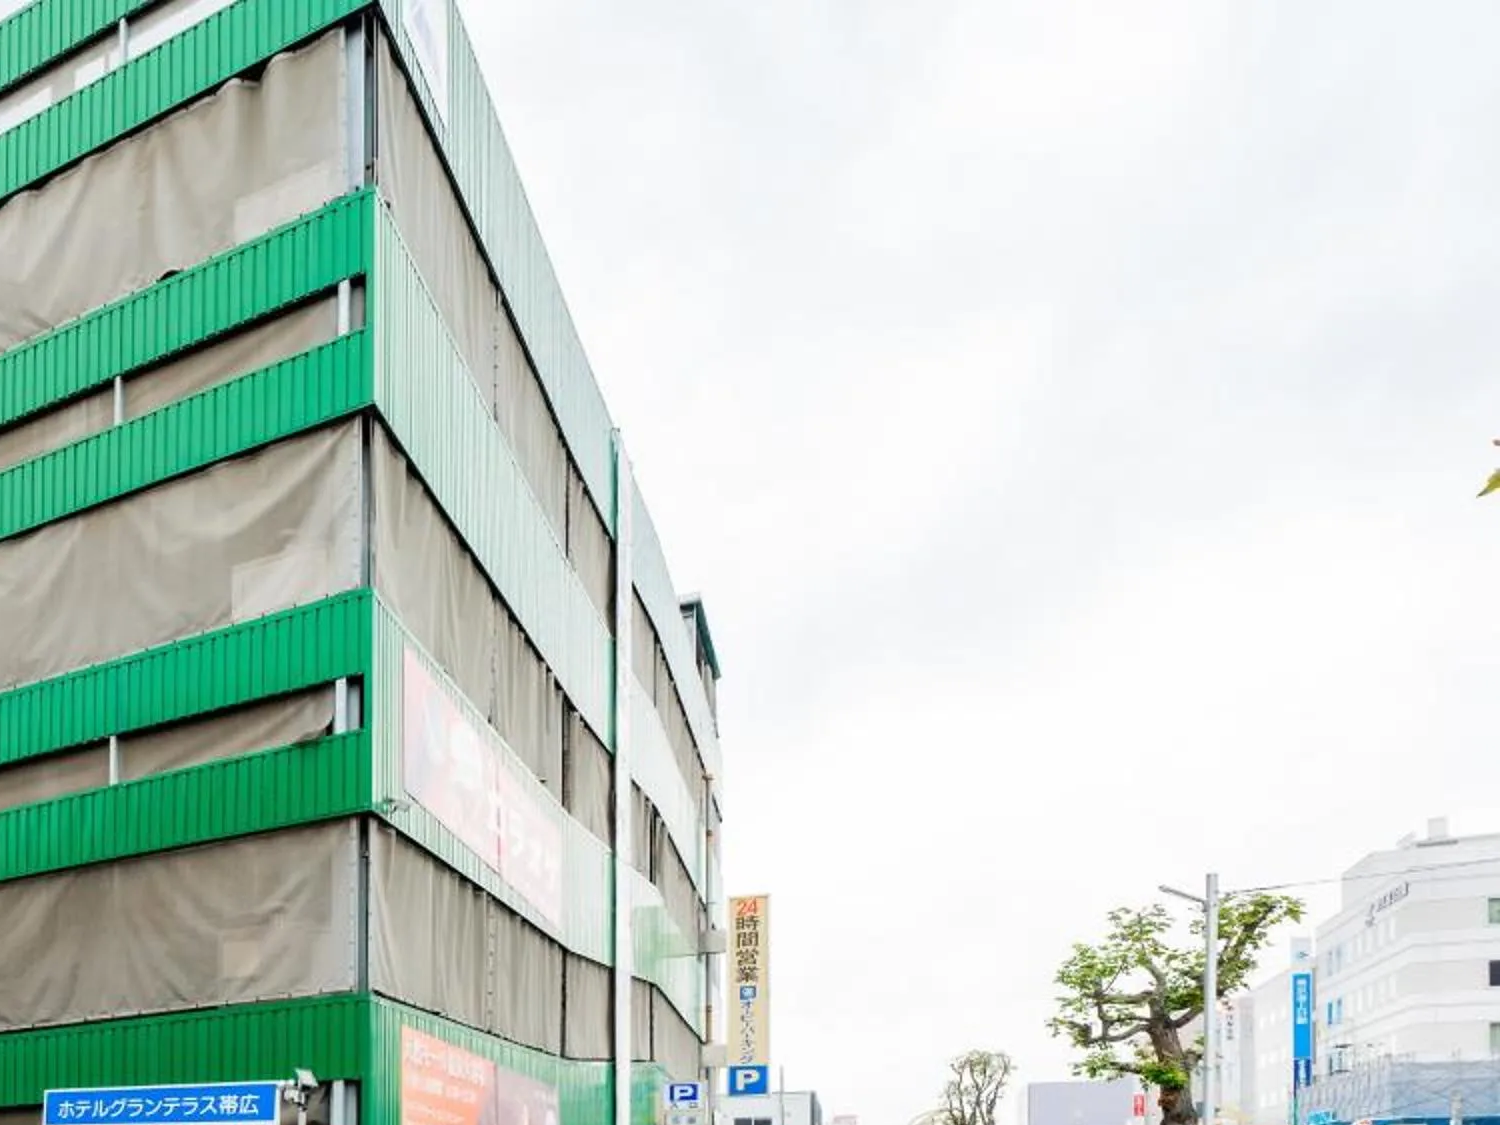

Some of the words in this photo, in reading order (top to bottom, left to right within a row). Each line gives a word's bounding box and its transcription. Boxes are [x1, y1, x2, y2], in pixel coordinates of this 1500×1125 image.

[735, 900, 760, 983] 24時間営業
[735, 1069, 760, 1091] P
[673, 1086, 694, 1101] P
[57, 1094, 260, 1119] ホテルグランテラス帯広
